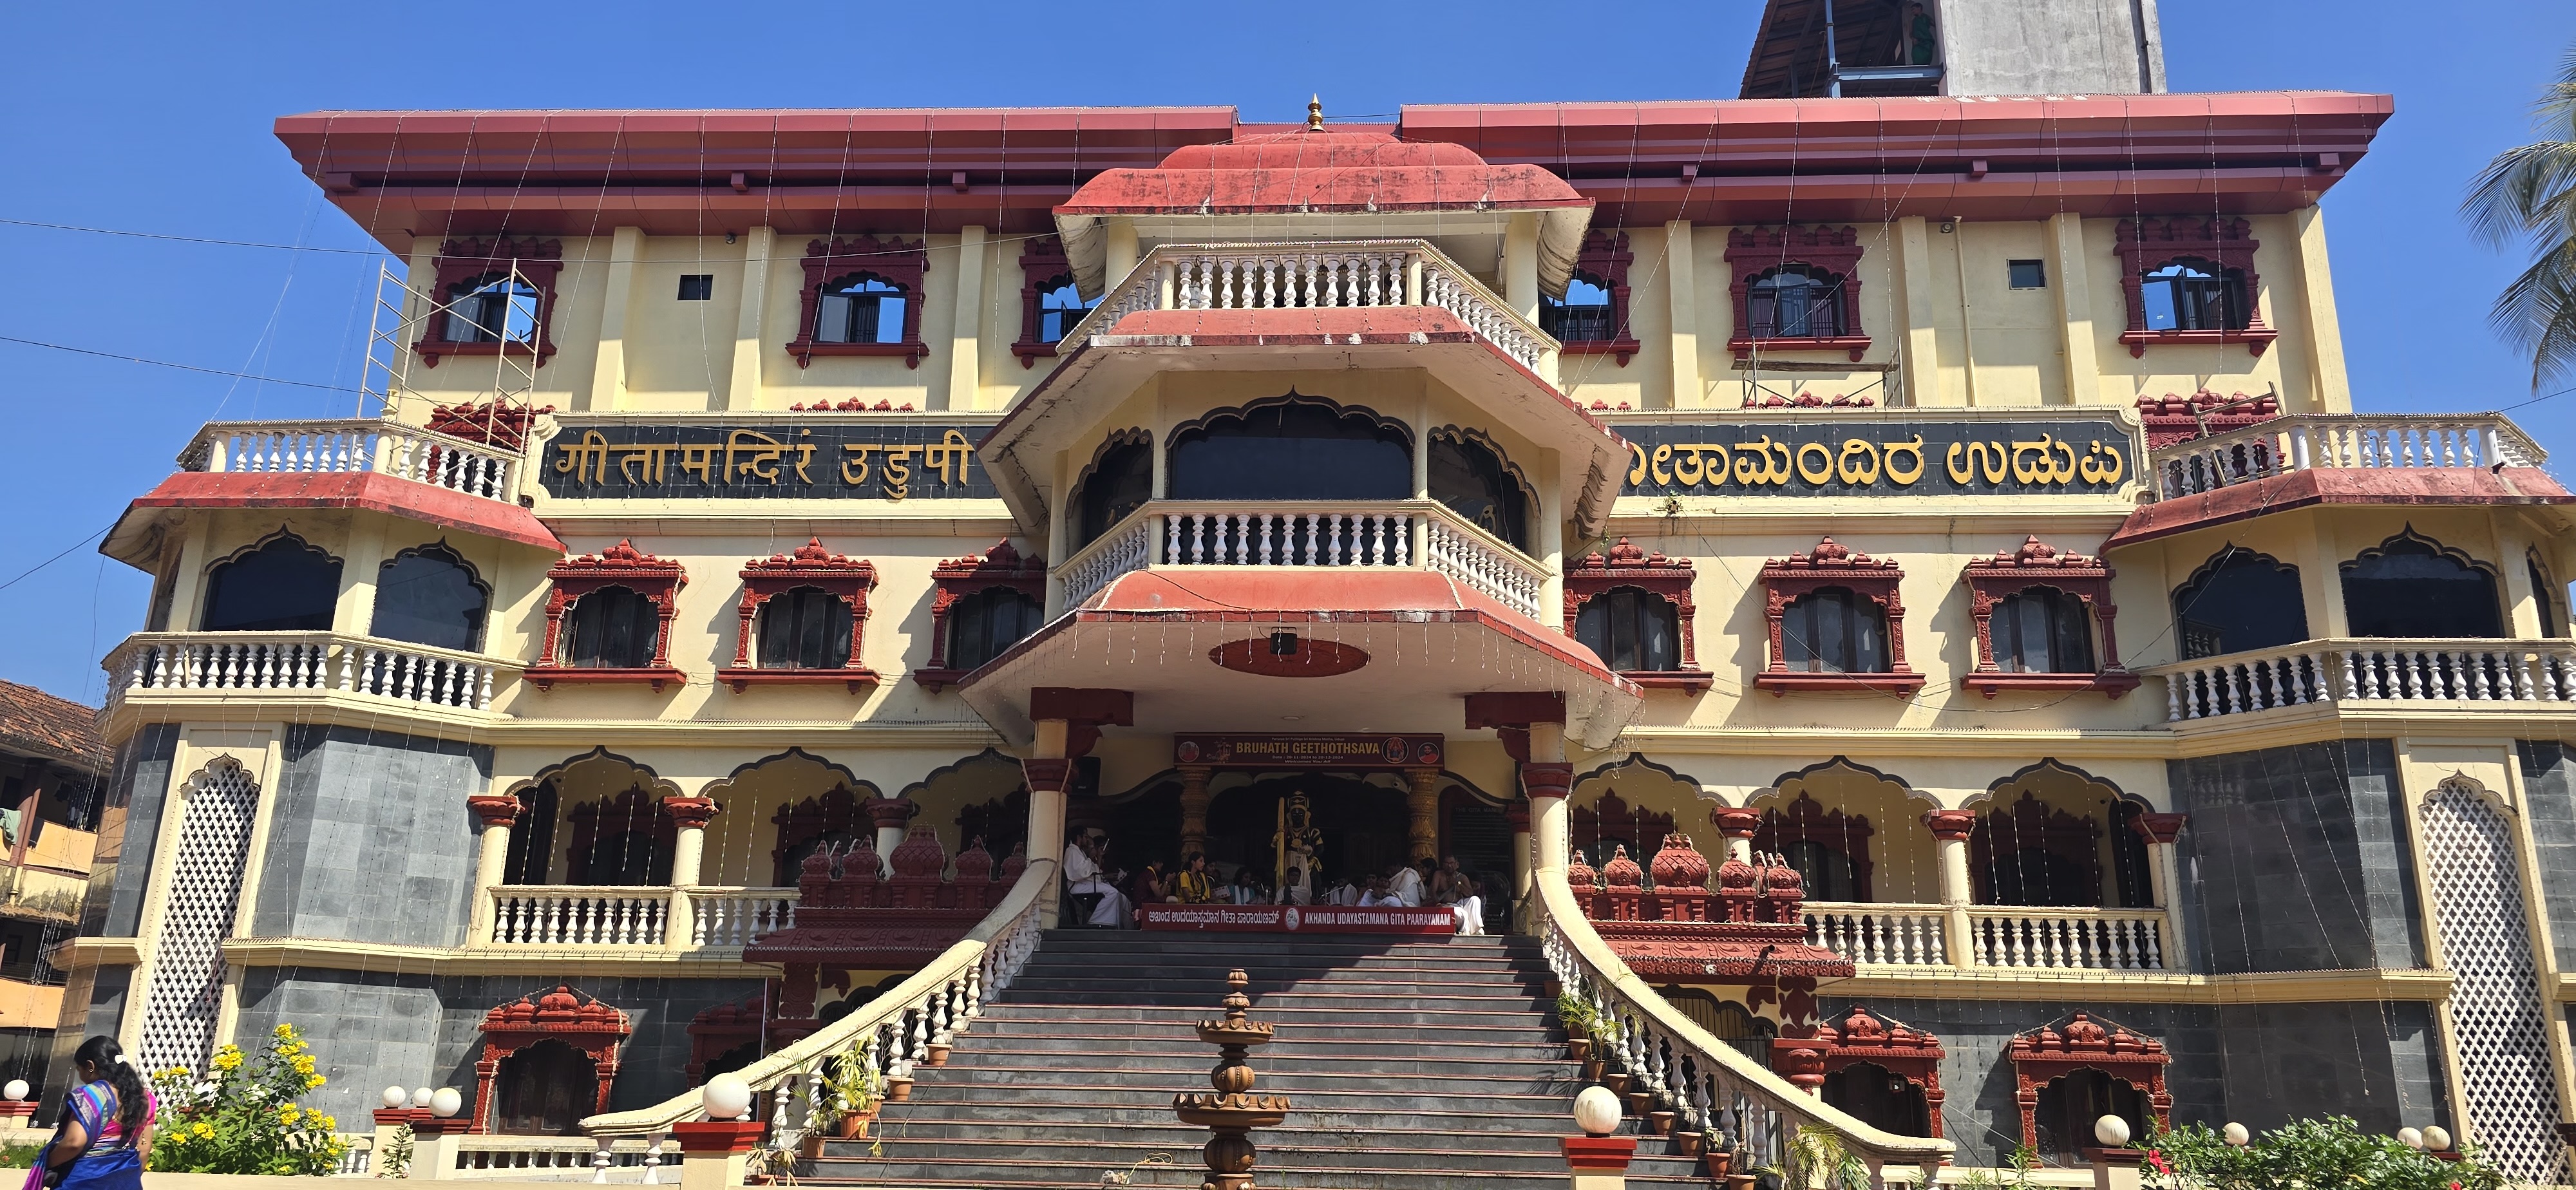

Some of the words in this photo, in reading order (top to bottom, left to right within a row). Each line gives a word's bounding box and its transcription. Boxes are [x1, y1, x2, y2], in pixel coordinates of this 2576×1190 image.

[554, 428, 818, 486] गीतामन्दिरं
[842, 430, 976, 500] उडुपी
[1947, 432, 2123, 485] ಉಡುಪಿ
[1236, 742, 1289, 753] BRUHATH
[1293, 742, 1380, 754] GEETHOTHSAVA
[1149, 909, 1171, 921] ಅಖಂಡ
[1171, 909, 1219, 928] ಉದಯಾಸ್ತಮಾನ
[1220, 909, 1236, 923] ಗೀತಾ
[1237, 910, 1280, 924] ಪಾರಾಯಣಮ್
[1305, 912, 1336, 924] AKHANDA
[1337, 912, 1389, 925] UDAYASTAMANA
[1390, 913, 1405, 925] GITA
[1406, 913, 1450, 926] PAARAYANAM
